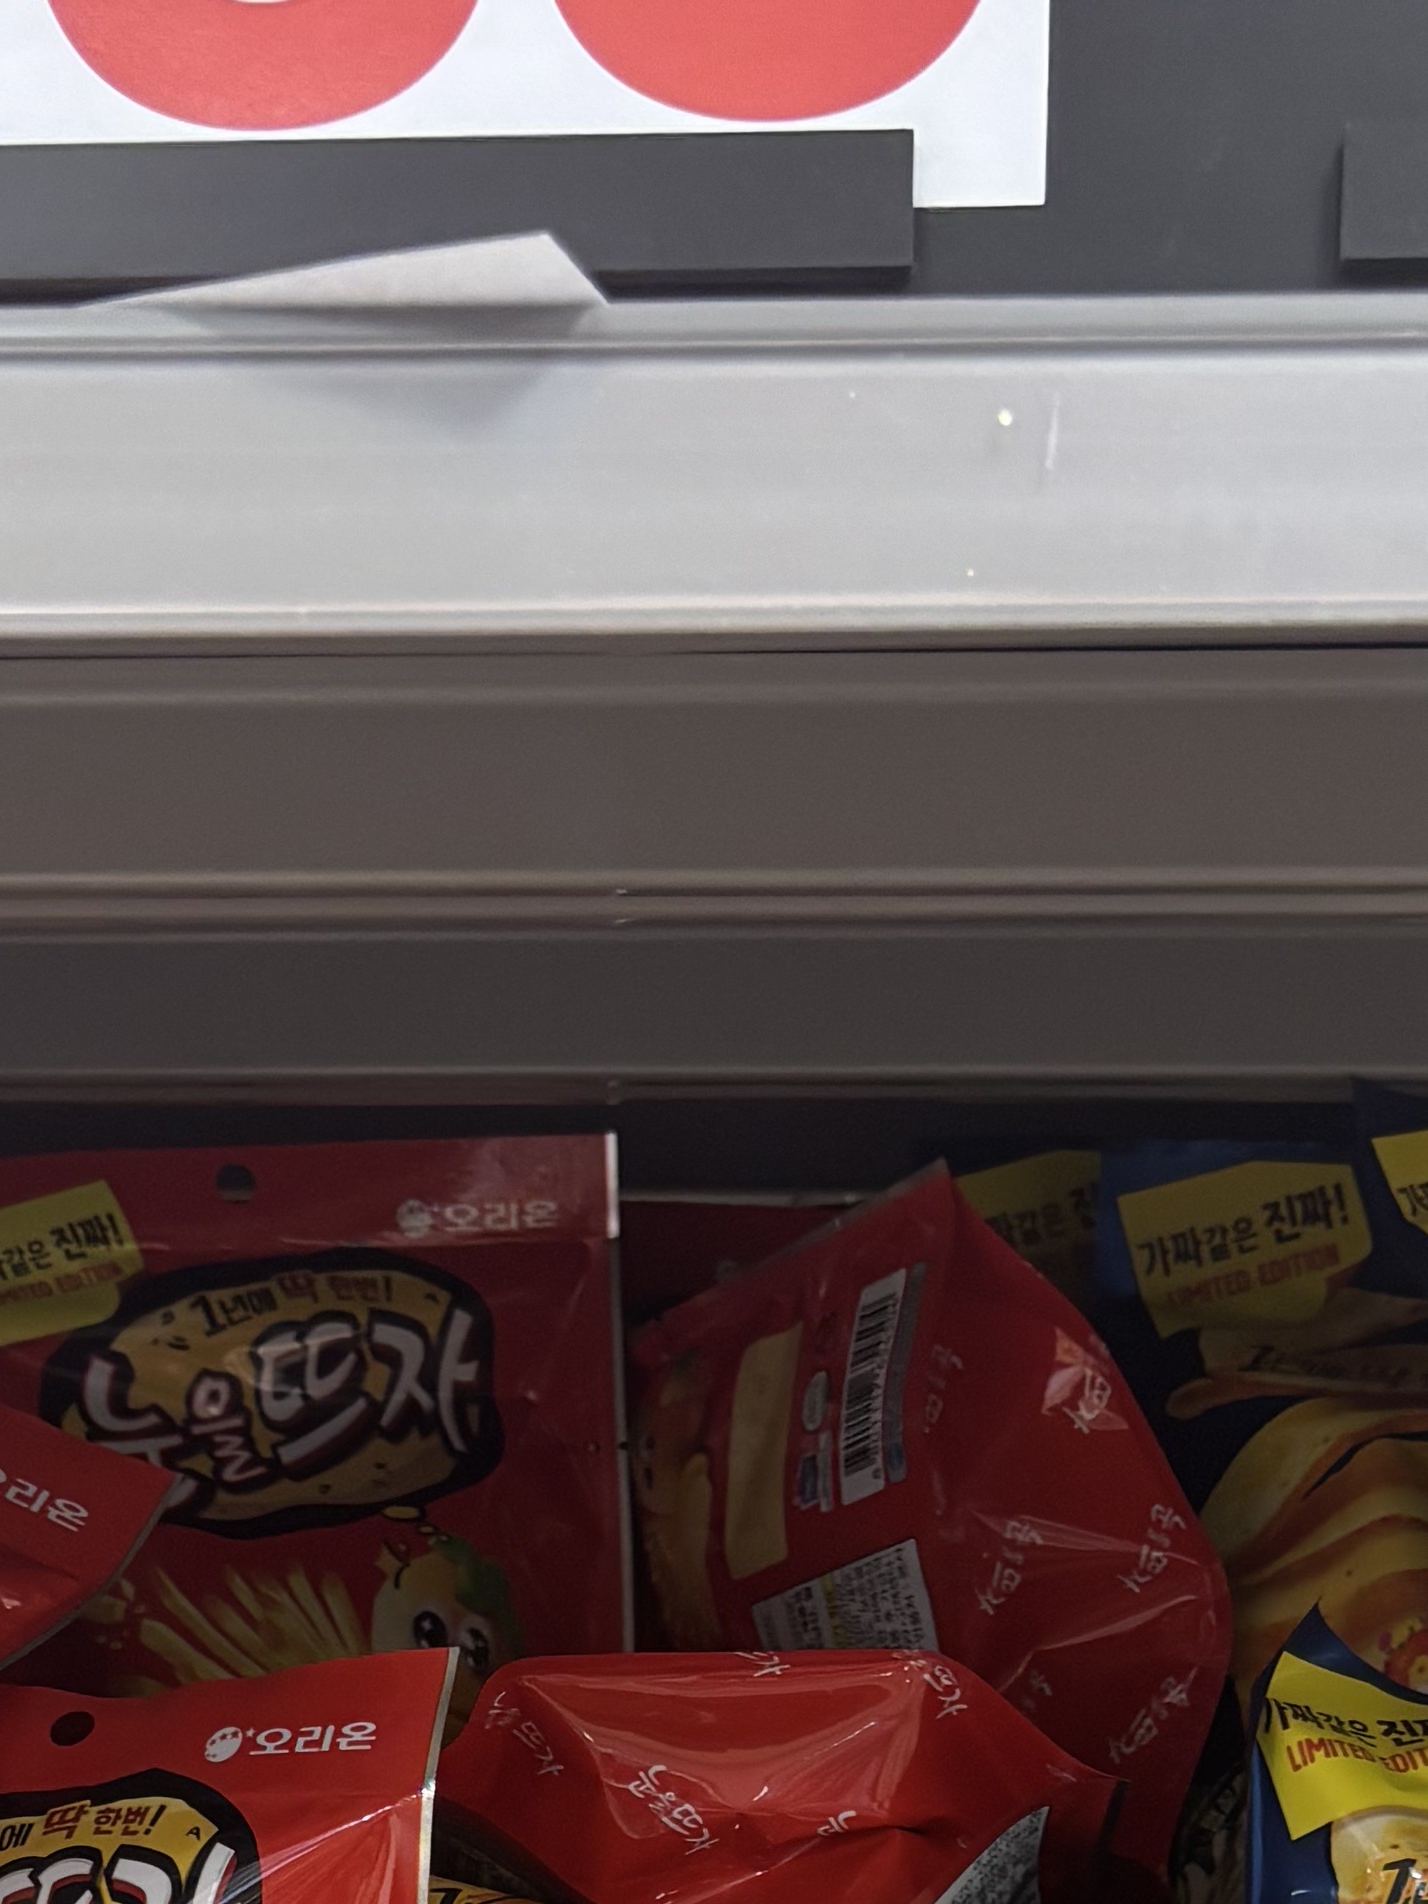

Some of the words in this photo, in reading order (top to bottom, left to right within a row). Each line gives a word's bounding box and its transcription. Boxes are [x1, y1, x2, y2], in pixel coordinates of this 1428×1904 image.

[51, 1212, 121, 1257] 진짜!
[443, 1201, 558, 1230] 오리온
[1136, 1224, 1260, 1277] 가짜같은
[1264, 1183, 1347, 1243] 진짜!
[189, 1286, 277, 1336] 1년에
[276, 1272, 318, 1309] 딱
[249, 1721, 377, 1756] 오리온
[43, 1803, 89, 1841] 딱
[94, 1805, 165, 1838] 한번!
